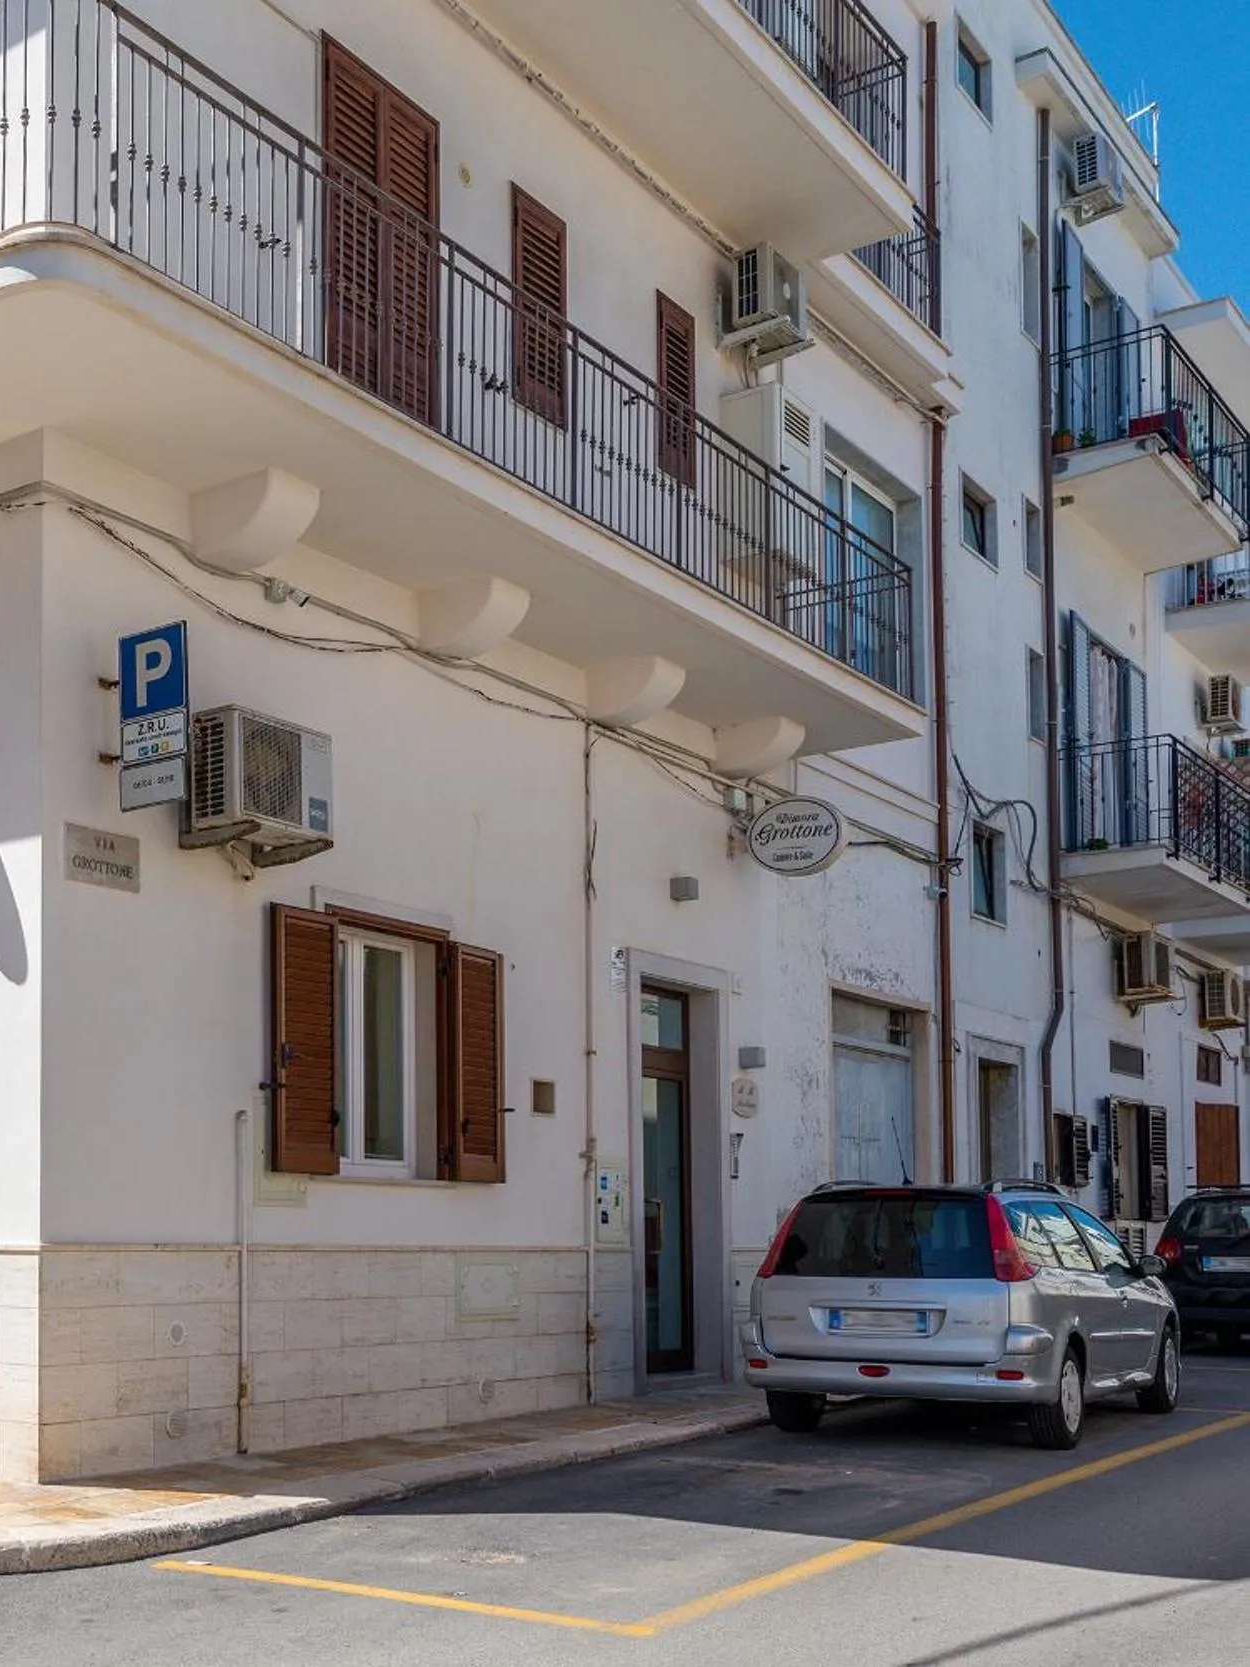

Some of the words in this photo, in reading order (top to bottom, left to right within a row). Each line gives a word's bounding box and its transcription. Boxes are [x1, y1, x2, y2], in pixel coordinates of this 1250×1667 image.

[136, 639, 172, 708] P
[137, 718, 169, 736] Z.R.U.
[94, 835, 116, 852] VIA
[754, 823, 833, 846] Grottone
[72, 854, 134, 880] GROTTONE
